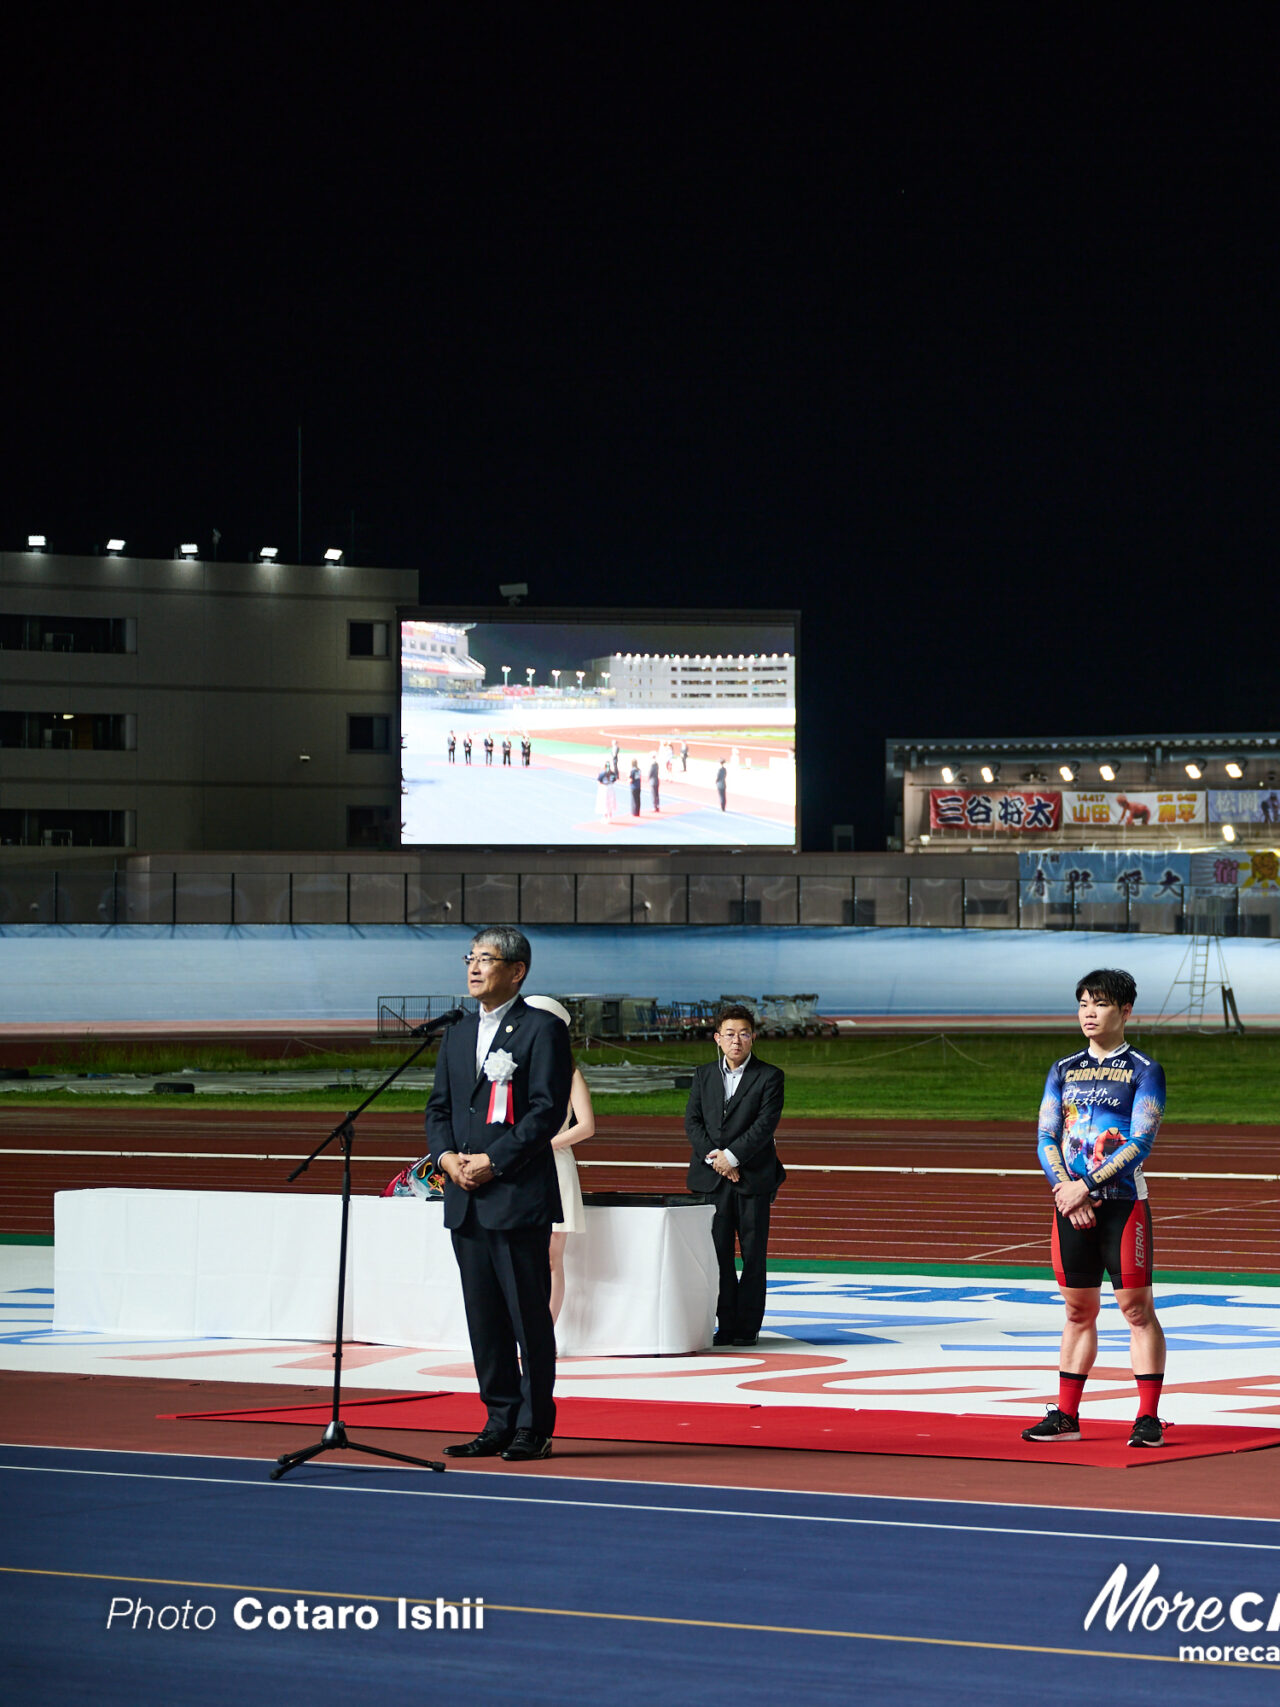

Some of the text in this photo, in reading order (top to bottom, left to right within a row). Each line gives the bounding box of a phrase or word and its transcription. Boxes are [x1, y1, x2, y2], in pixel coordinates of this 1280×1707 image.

[937, 796, 1055, 828] 三谷将太
[1072, 804, 1111, 823] 山田
[1065, 1067, 1134, 1083] CHAMPION
[1068, 1096, 1121, 1107] フェスティバル
[1091, 1142, 1141, 1184] CHAMPION
[1135, 1221, 1145, 1268] KEIRIN
